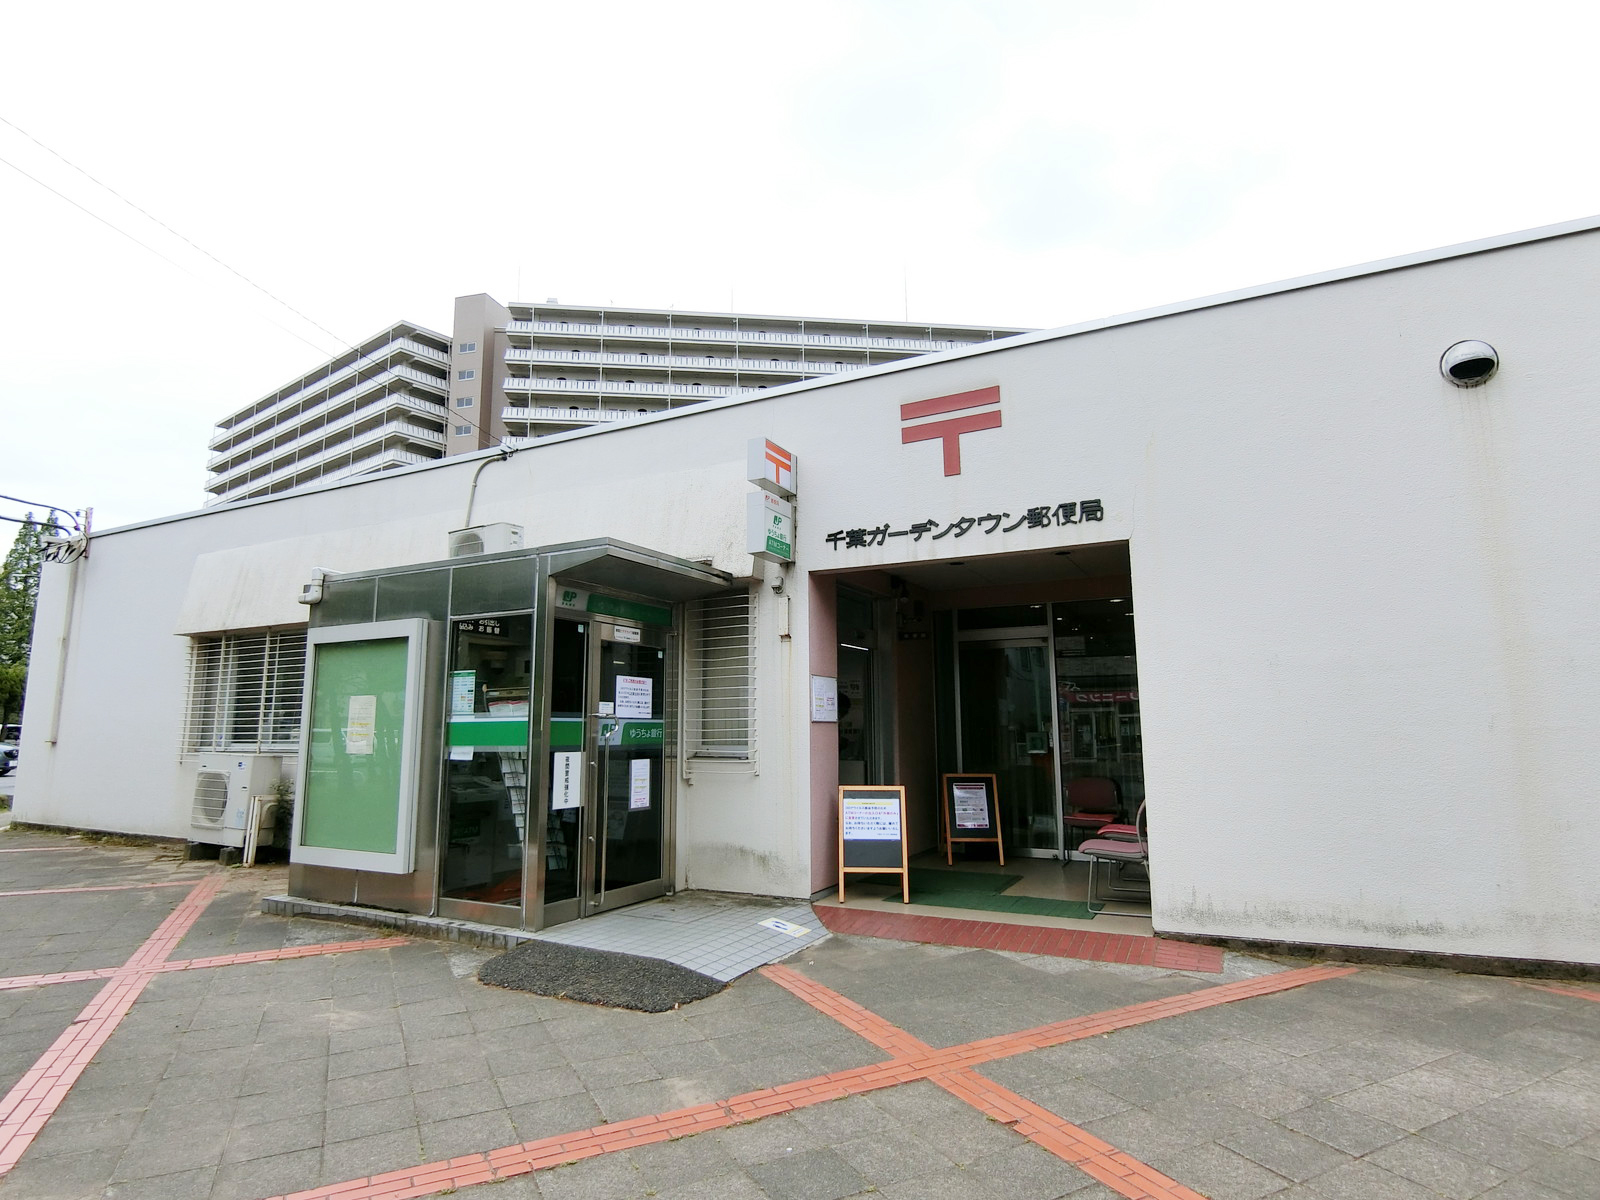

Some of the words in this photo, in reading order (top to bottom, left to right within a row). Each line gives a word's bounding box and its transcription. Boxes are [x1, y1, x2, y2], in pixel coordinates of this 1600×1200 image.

[826, 498, 1104, 550] 千葉ガーデンタウン郵便局
[629, 728, 663, 738] ゆうちょ銀行
